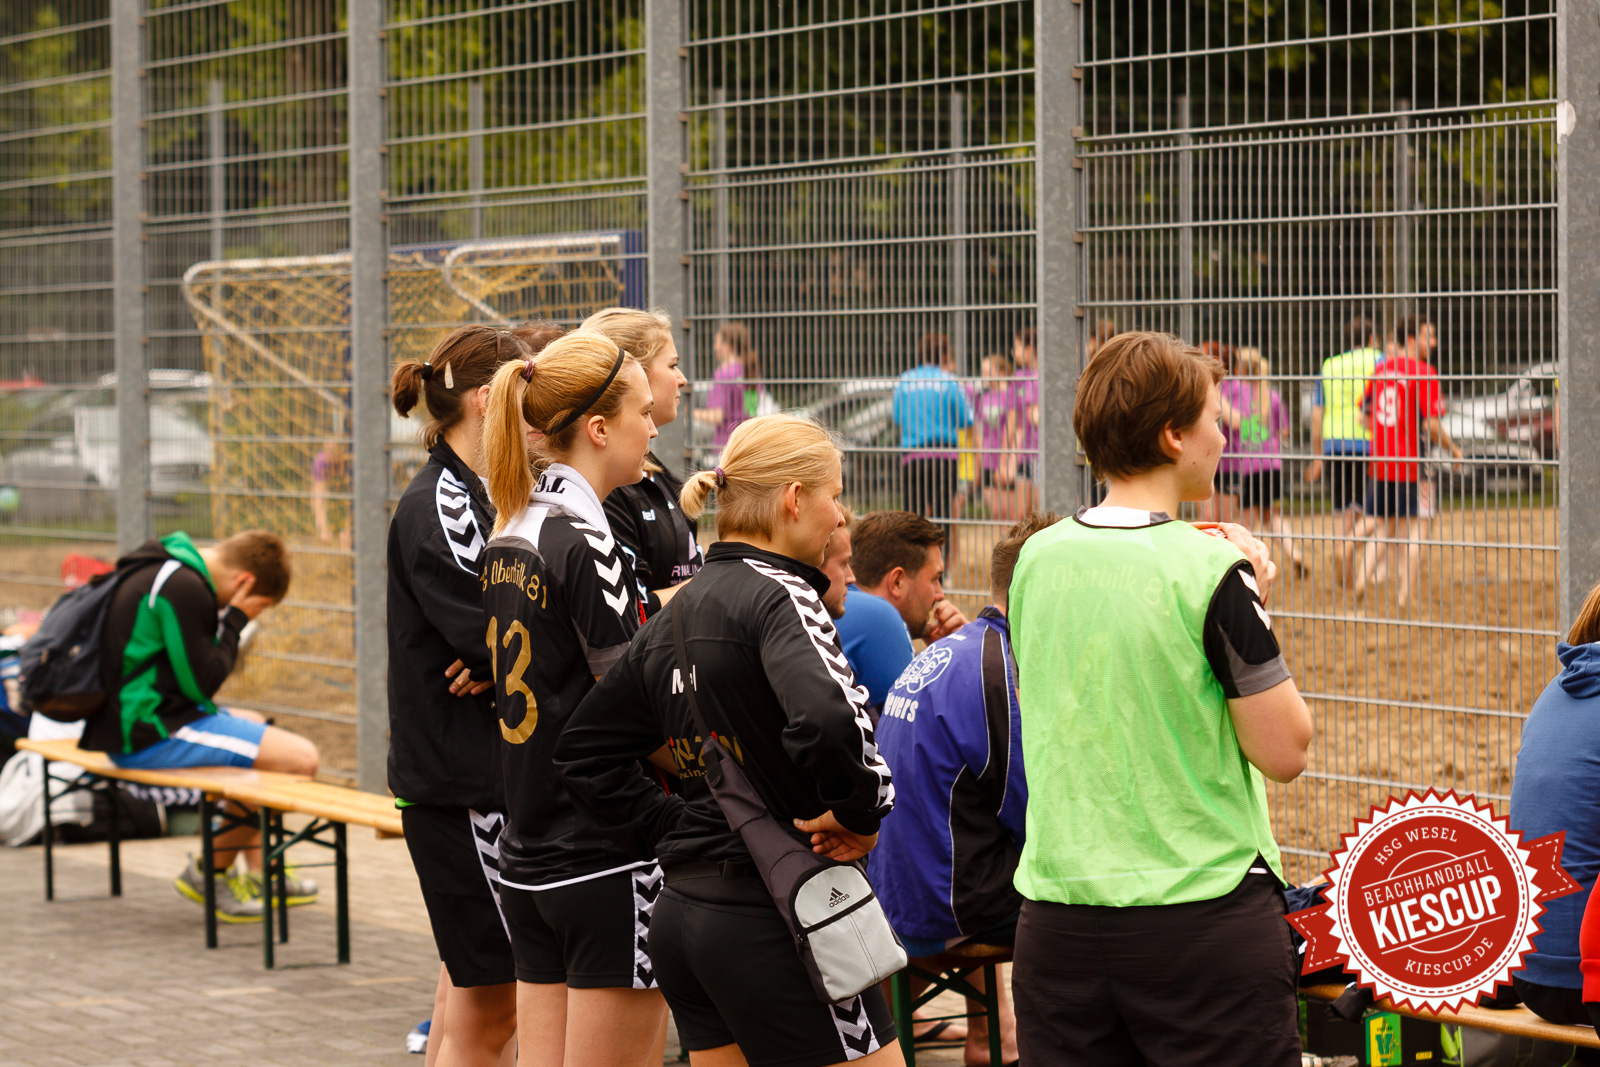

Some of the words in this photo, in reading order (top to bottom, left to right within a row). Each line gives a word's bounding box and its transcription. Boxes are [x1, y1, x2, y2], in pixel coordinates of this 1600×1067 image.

[1376, 385, 1402, 428] 9
[491, 557, 527, 592] Oberbilk
[485, 615, 539, 745] 13
[828, 893, 851, 909] adidas
